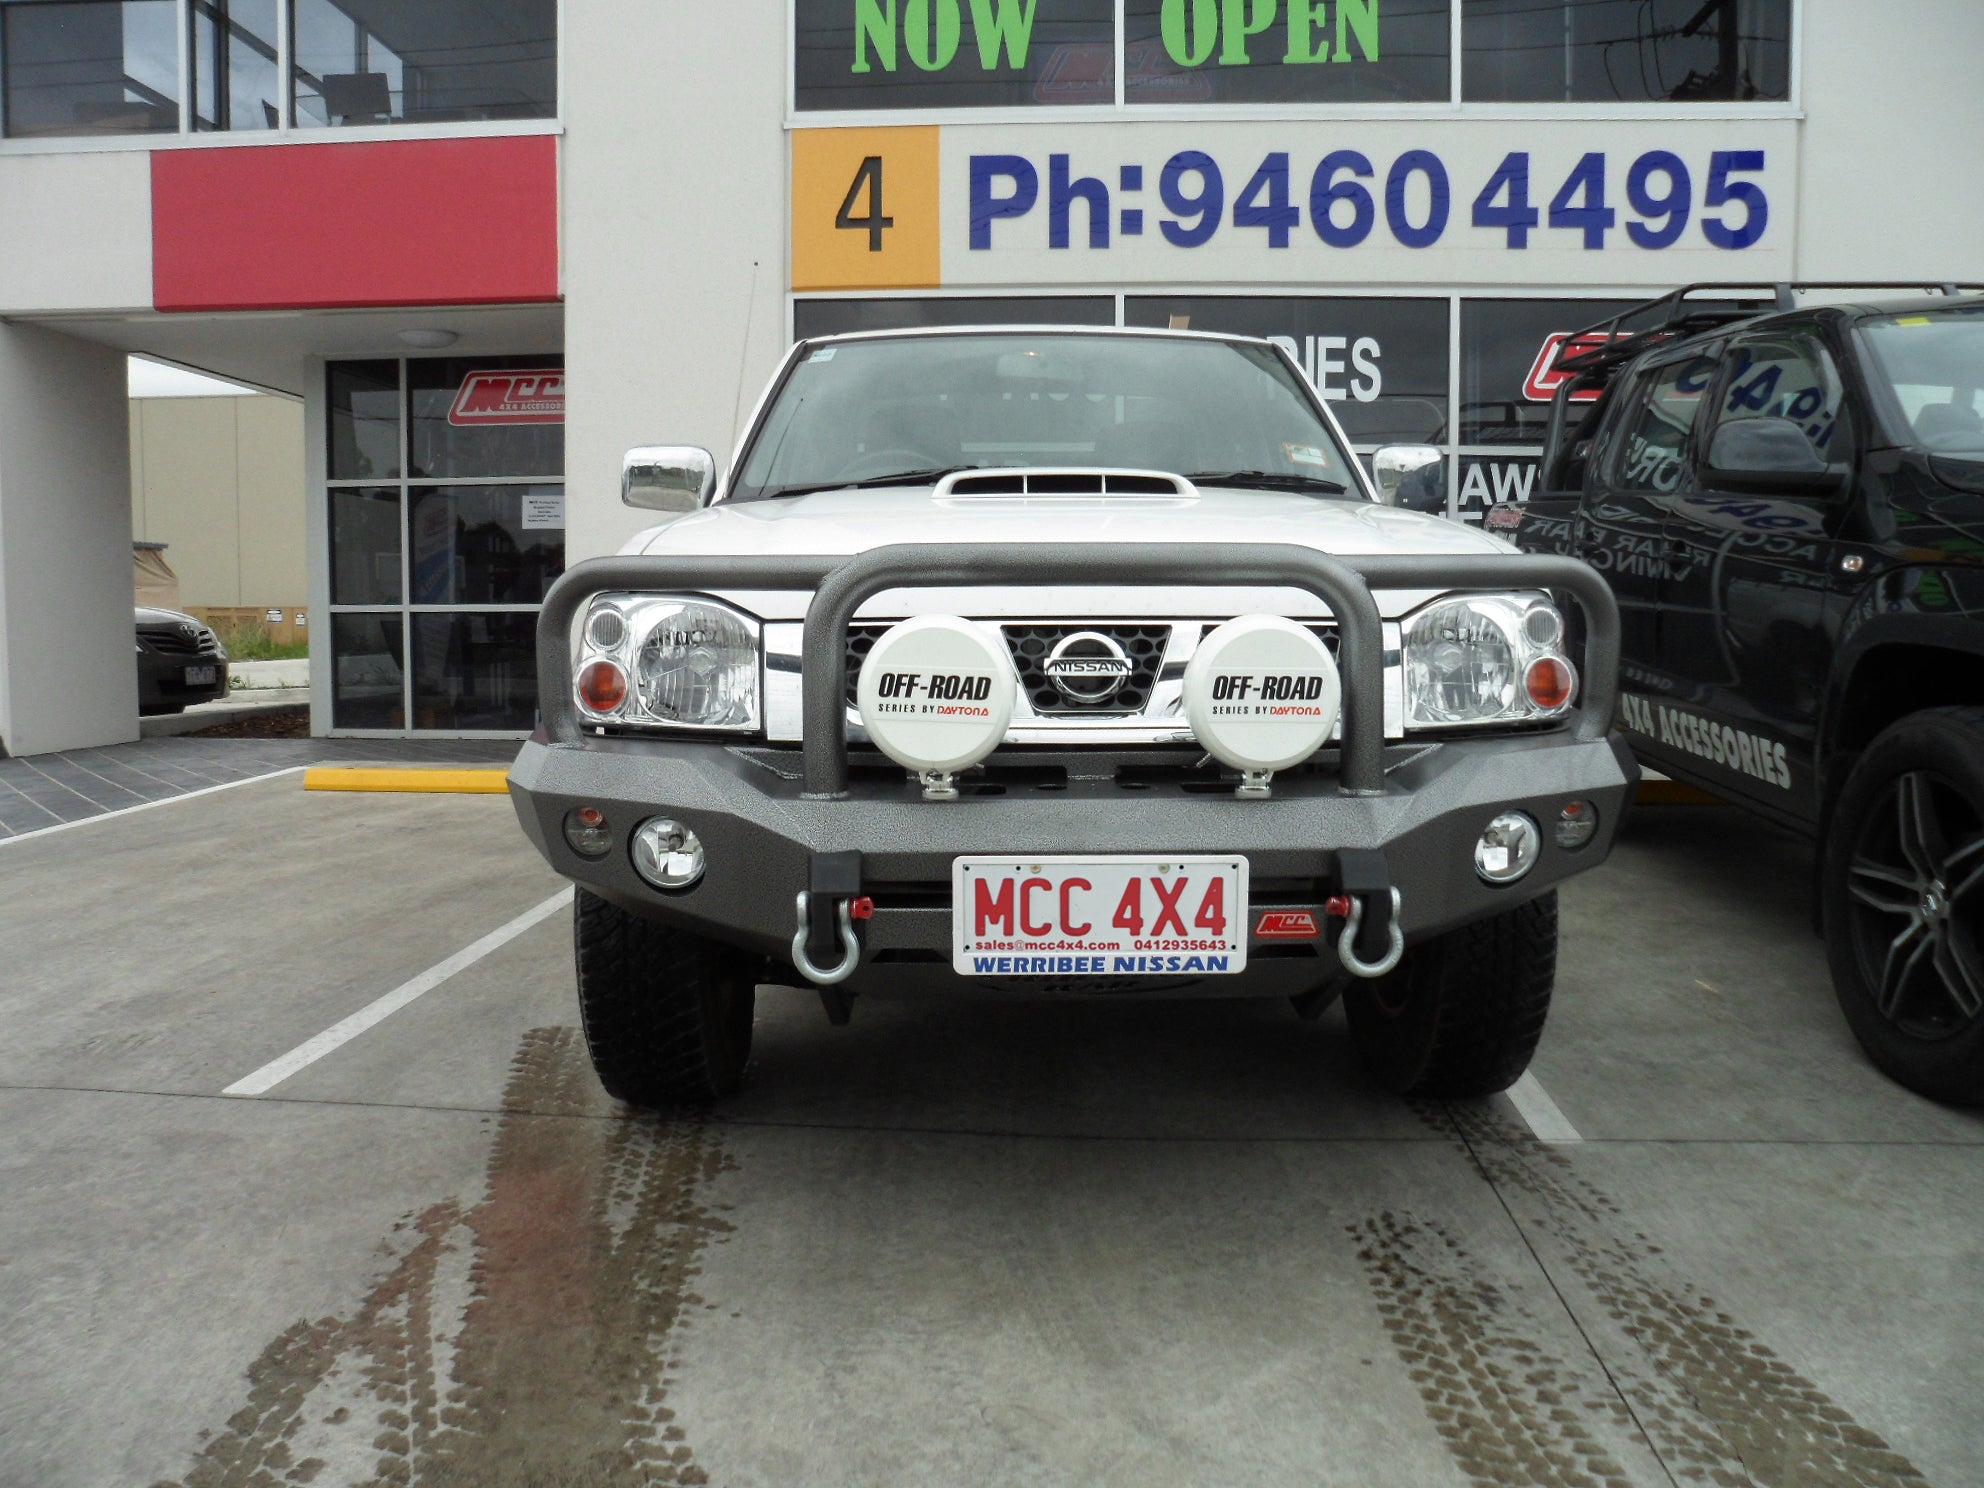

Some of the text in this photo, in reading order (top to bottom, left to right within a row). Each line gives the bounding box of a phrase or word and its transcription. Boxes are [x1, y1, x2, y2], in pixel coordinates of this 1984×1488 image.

[851, 0, 1379, 73] NOW OPEN
[835, 155, 894, 252] 4
[1054, 661, 1124, 672] NISSAN
[878, 672, 992, 701] OFF-ROAD
[1212, 676, 1323, 700] OFF-ROAD
[878, 703, 989, 716] SERIES BY DAYTONA
[1212, 706, 1321, 716] SERIES BY DAYTONA
[1622, 693, 1791, 790] 4X4 ACCESSORIES
[975, 877, 1226, 937] MCC 4X4
[975, 939, 1226, 952] sales@mcc4x4.com 0412935643
[974, 956, 1228, 973] WERRIBEE NISSAN
